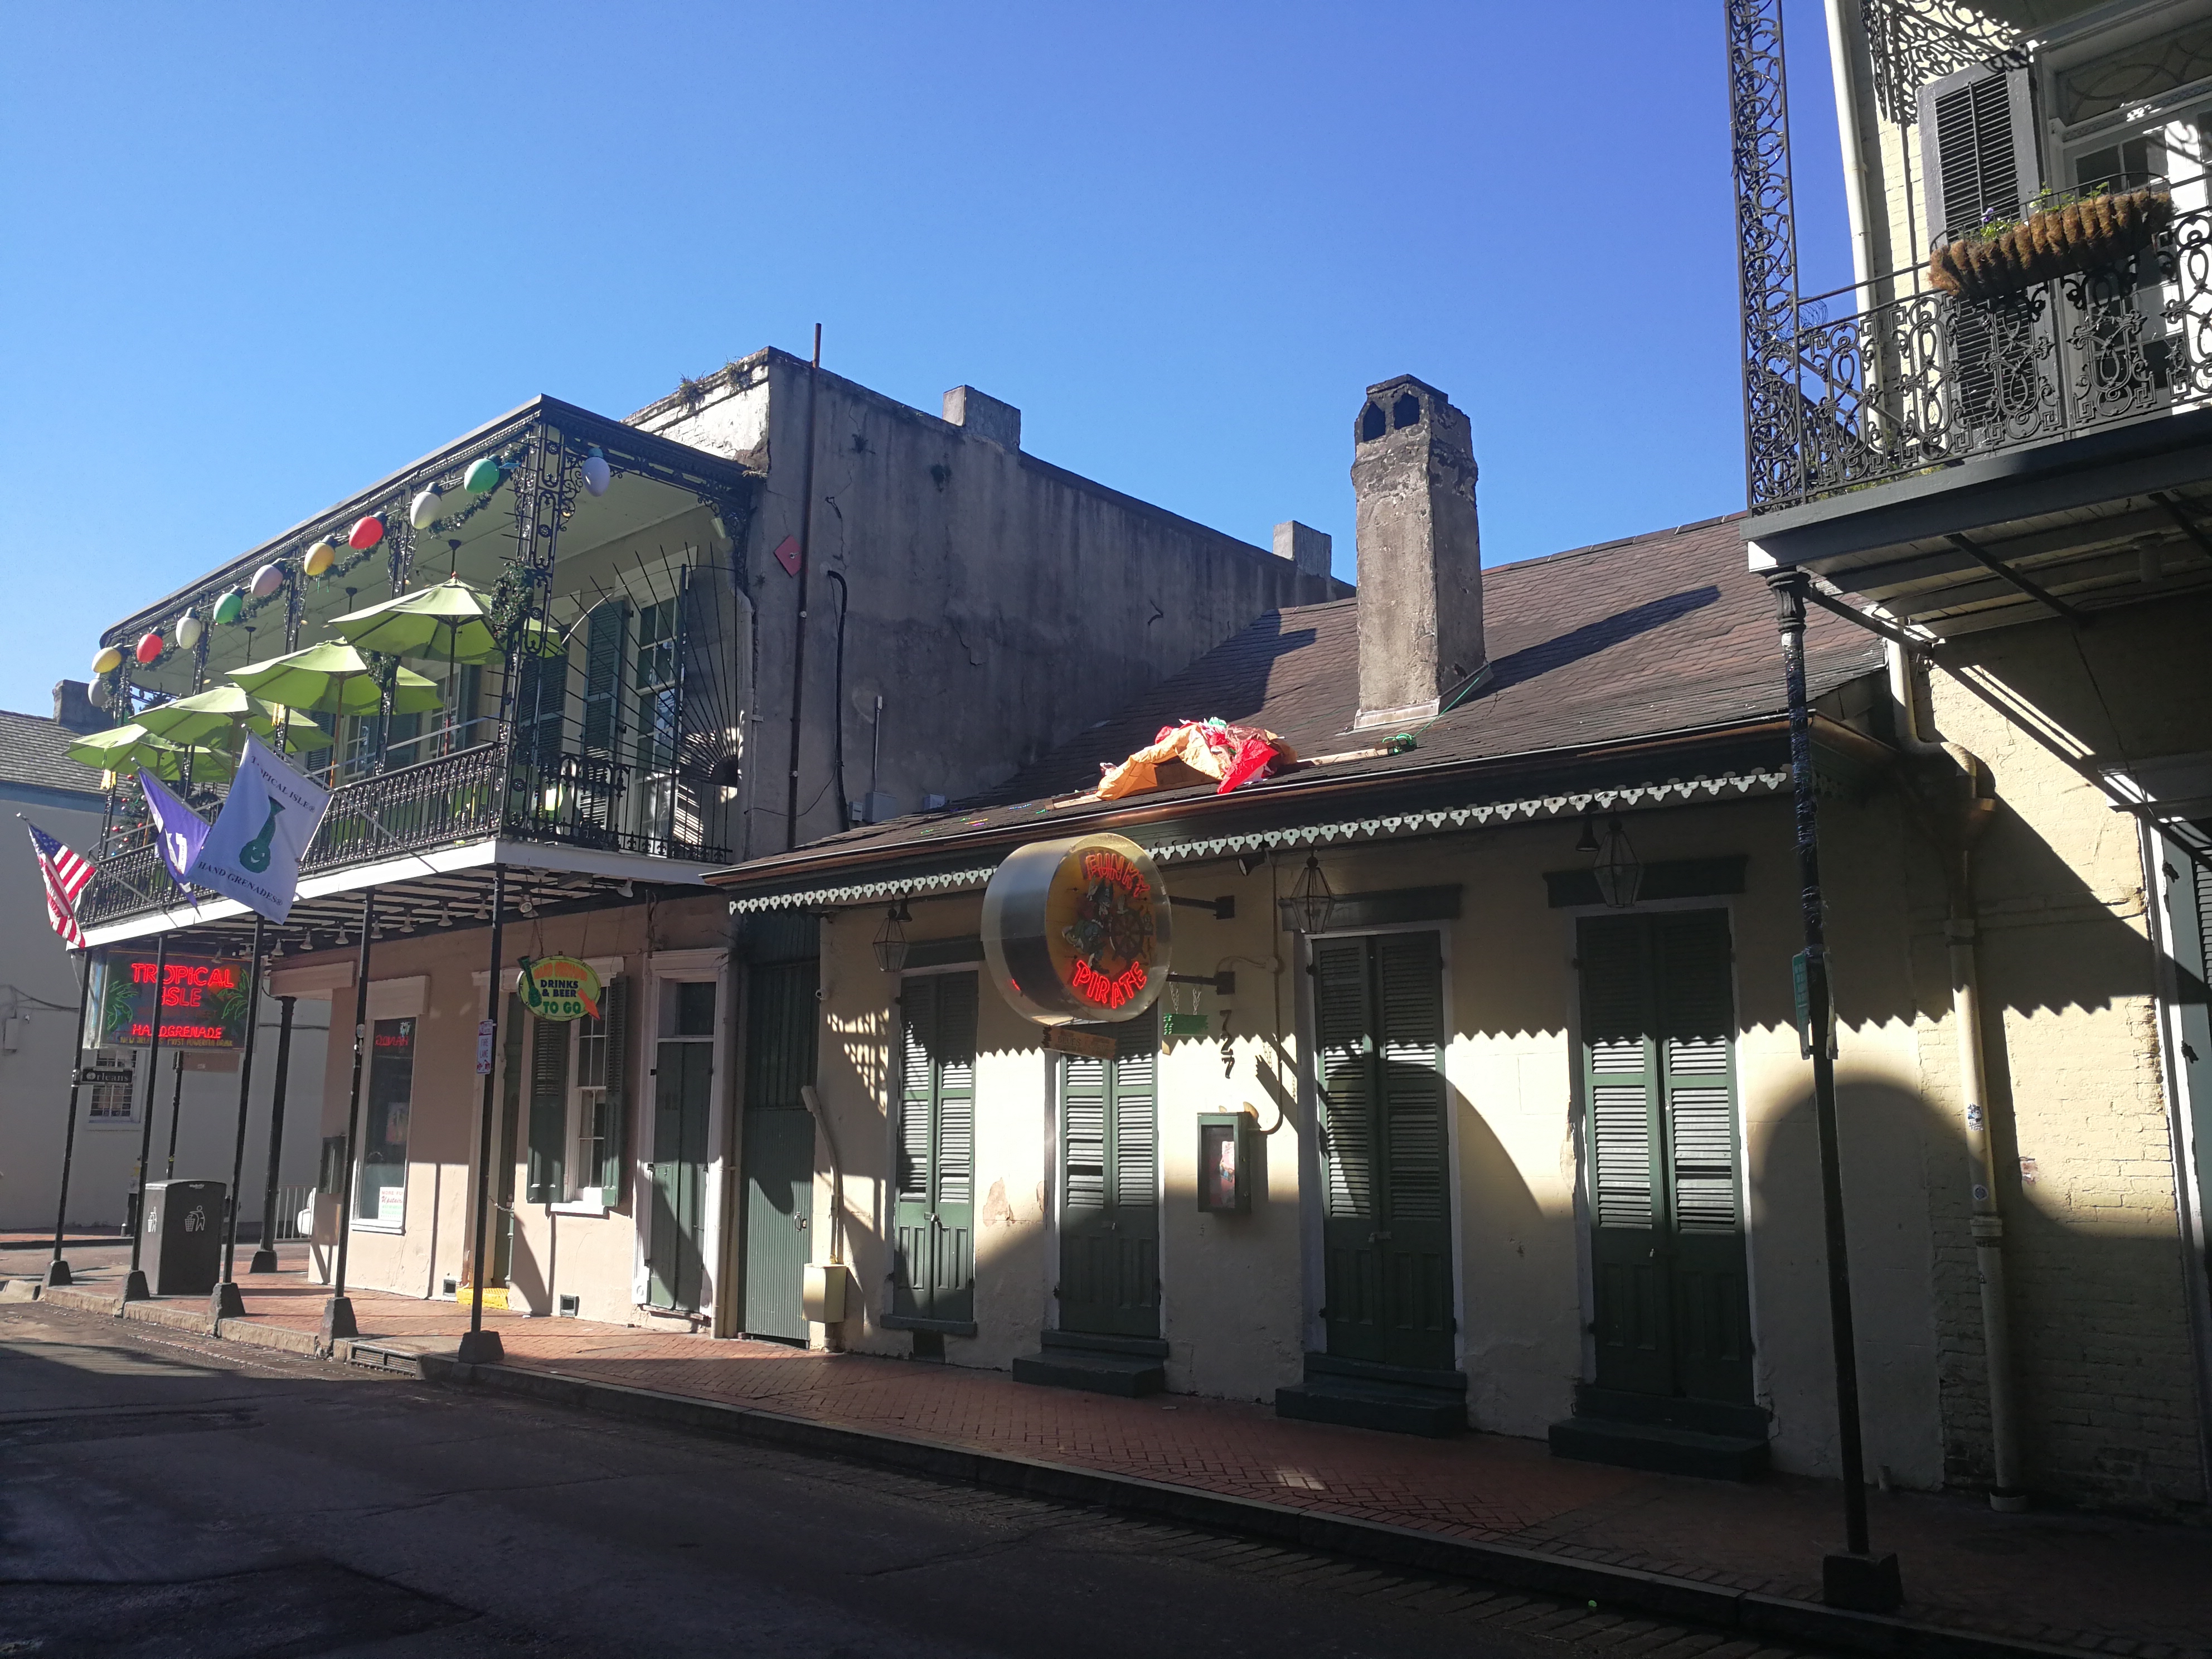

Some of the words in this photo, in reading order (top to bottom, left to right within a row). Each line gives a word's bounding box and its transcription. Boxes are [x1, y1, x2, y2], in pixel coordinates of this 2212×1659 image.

[251, 756, 288, 794] TPICAL
[198, 862, 226, 876] HAND
[1085, 852, 1151, 898] FUNKY
[540, 979, 579, 989] DRINKS
[1073, 959, 1147, 1010] PIRATE
[542, 988, 550, 997] &
[553, 989, 576, 997] BEER
[543, 1001, 559, 1014] TO
[563, 1001, 581, 1014] GO
[132, 1023, 222, 1039] HADGRENADE
[1058, 1036, 1081, 1046] BLUES
[480, 1049, 488, 1059] LANE
[86, 1071, 129, 1081] Orleans
